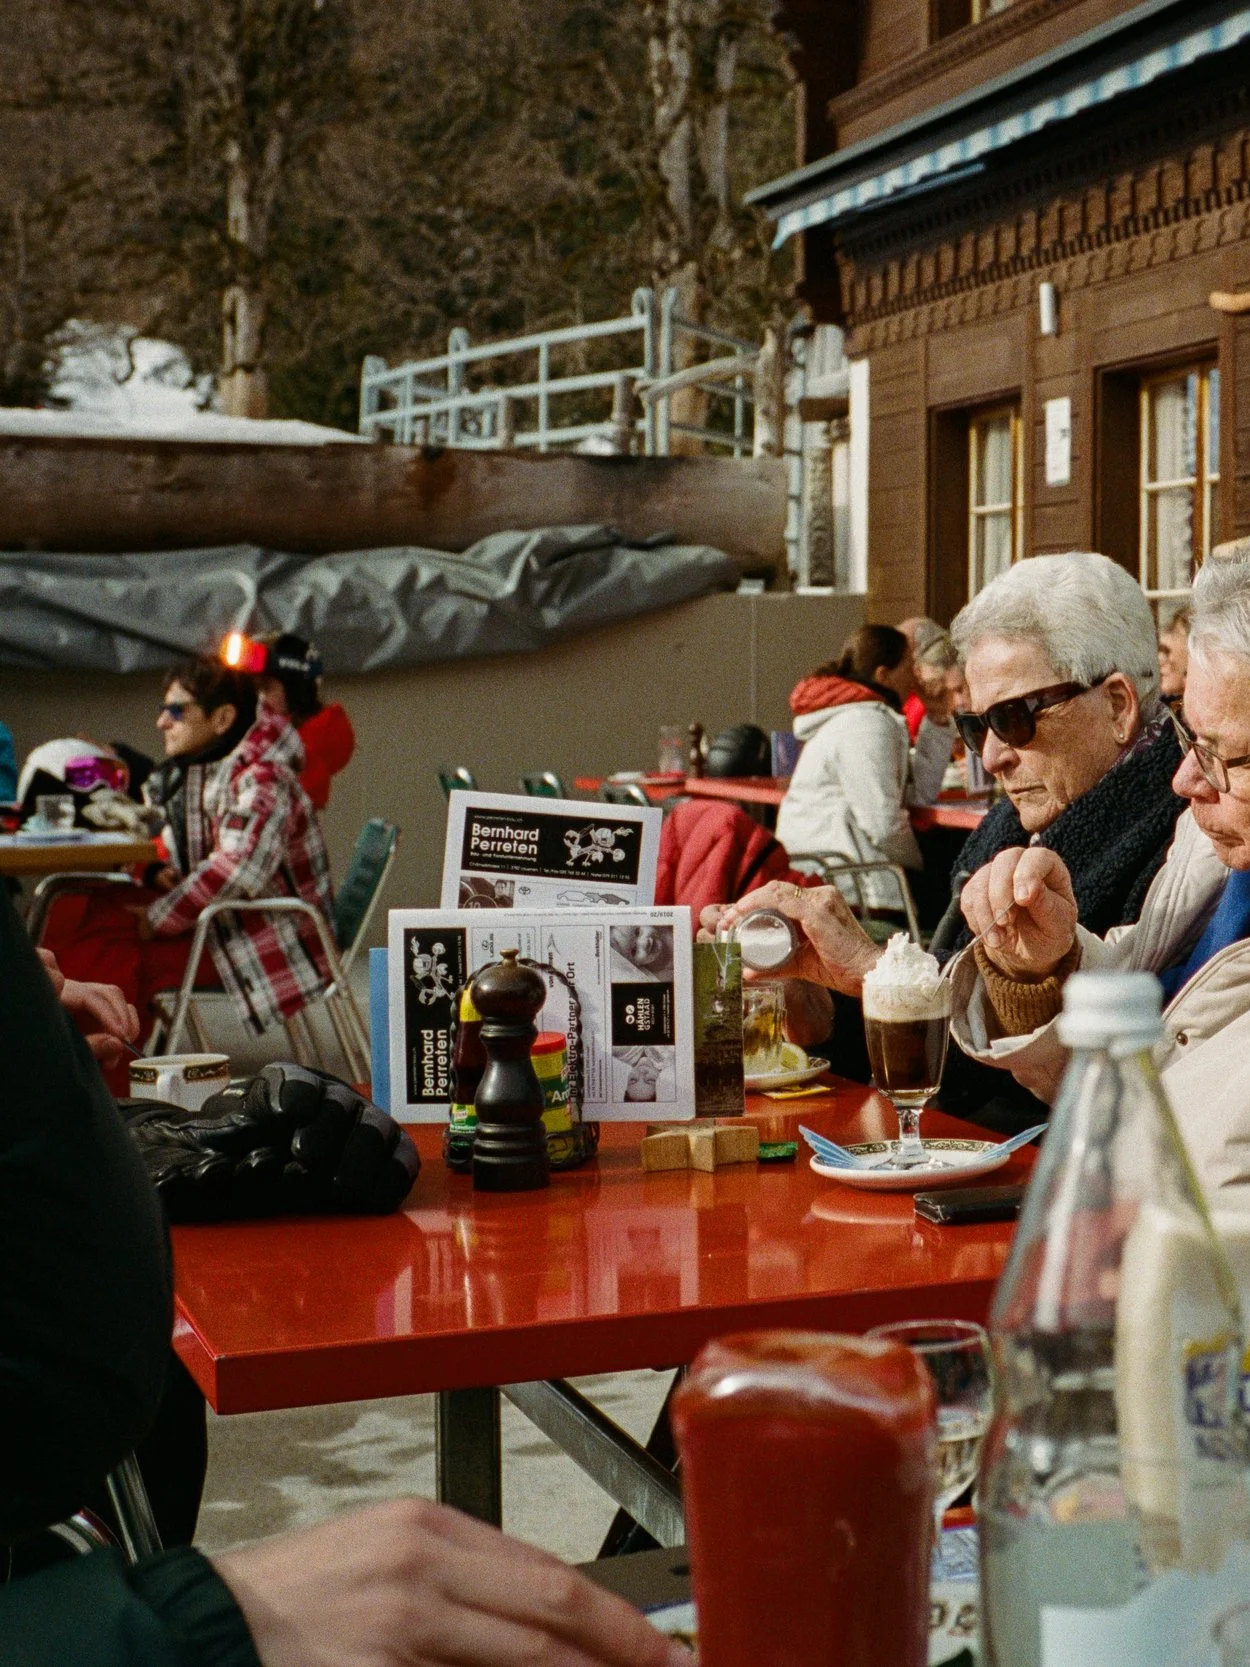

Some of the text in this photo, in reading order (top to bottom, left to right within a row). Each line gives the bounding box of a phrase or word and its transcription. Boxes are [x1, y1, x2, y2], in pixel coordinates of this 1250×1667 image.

[471, 822, 540, 841] Bernhard
[470, 836, 538, 855] Perreten
[566, 961, 575, 979] Ort
[421, 1029, 435, 1096] Bernhard
[435, 1029, 448, 1096] Perreten
